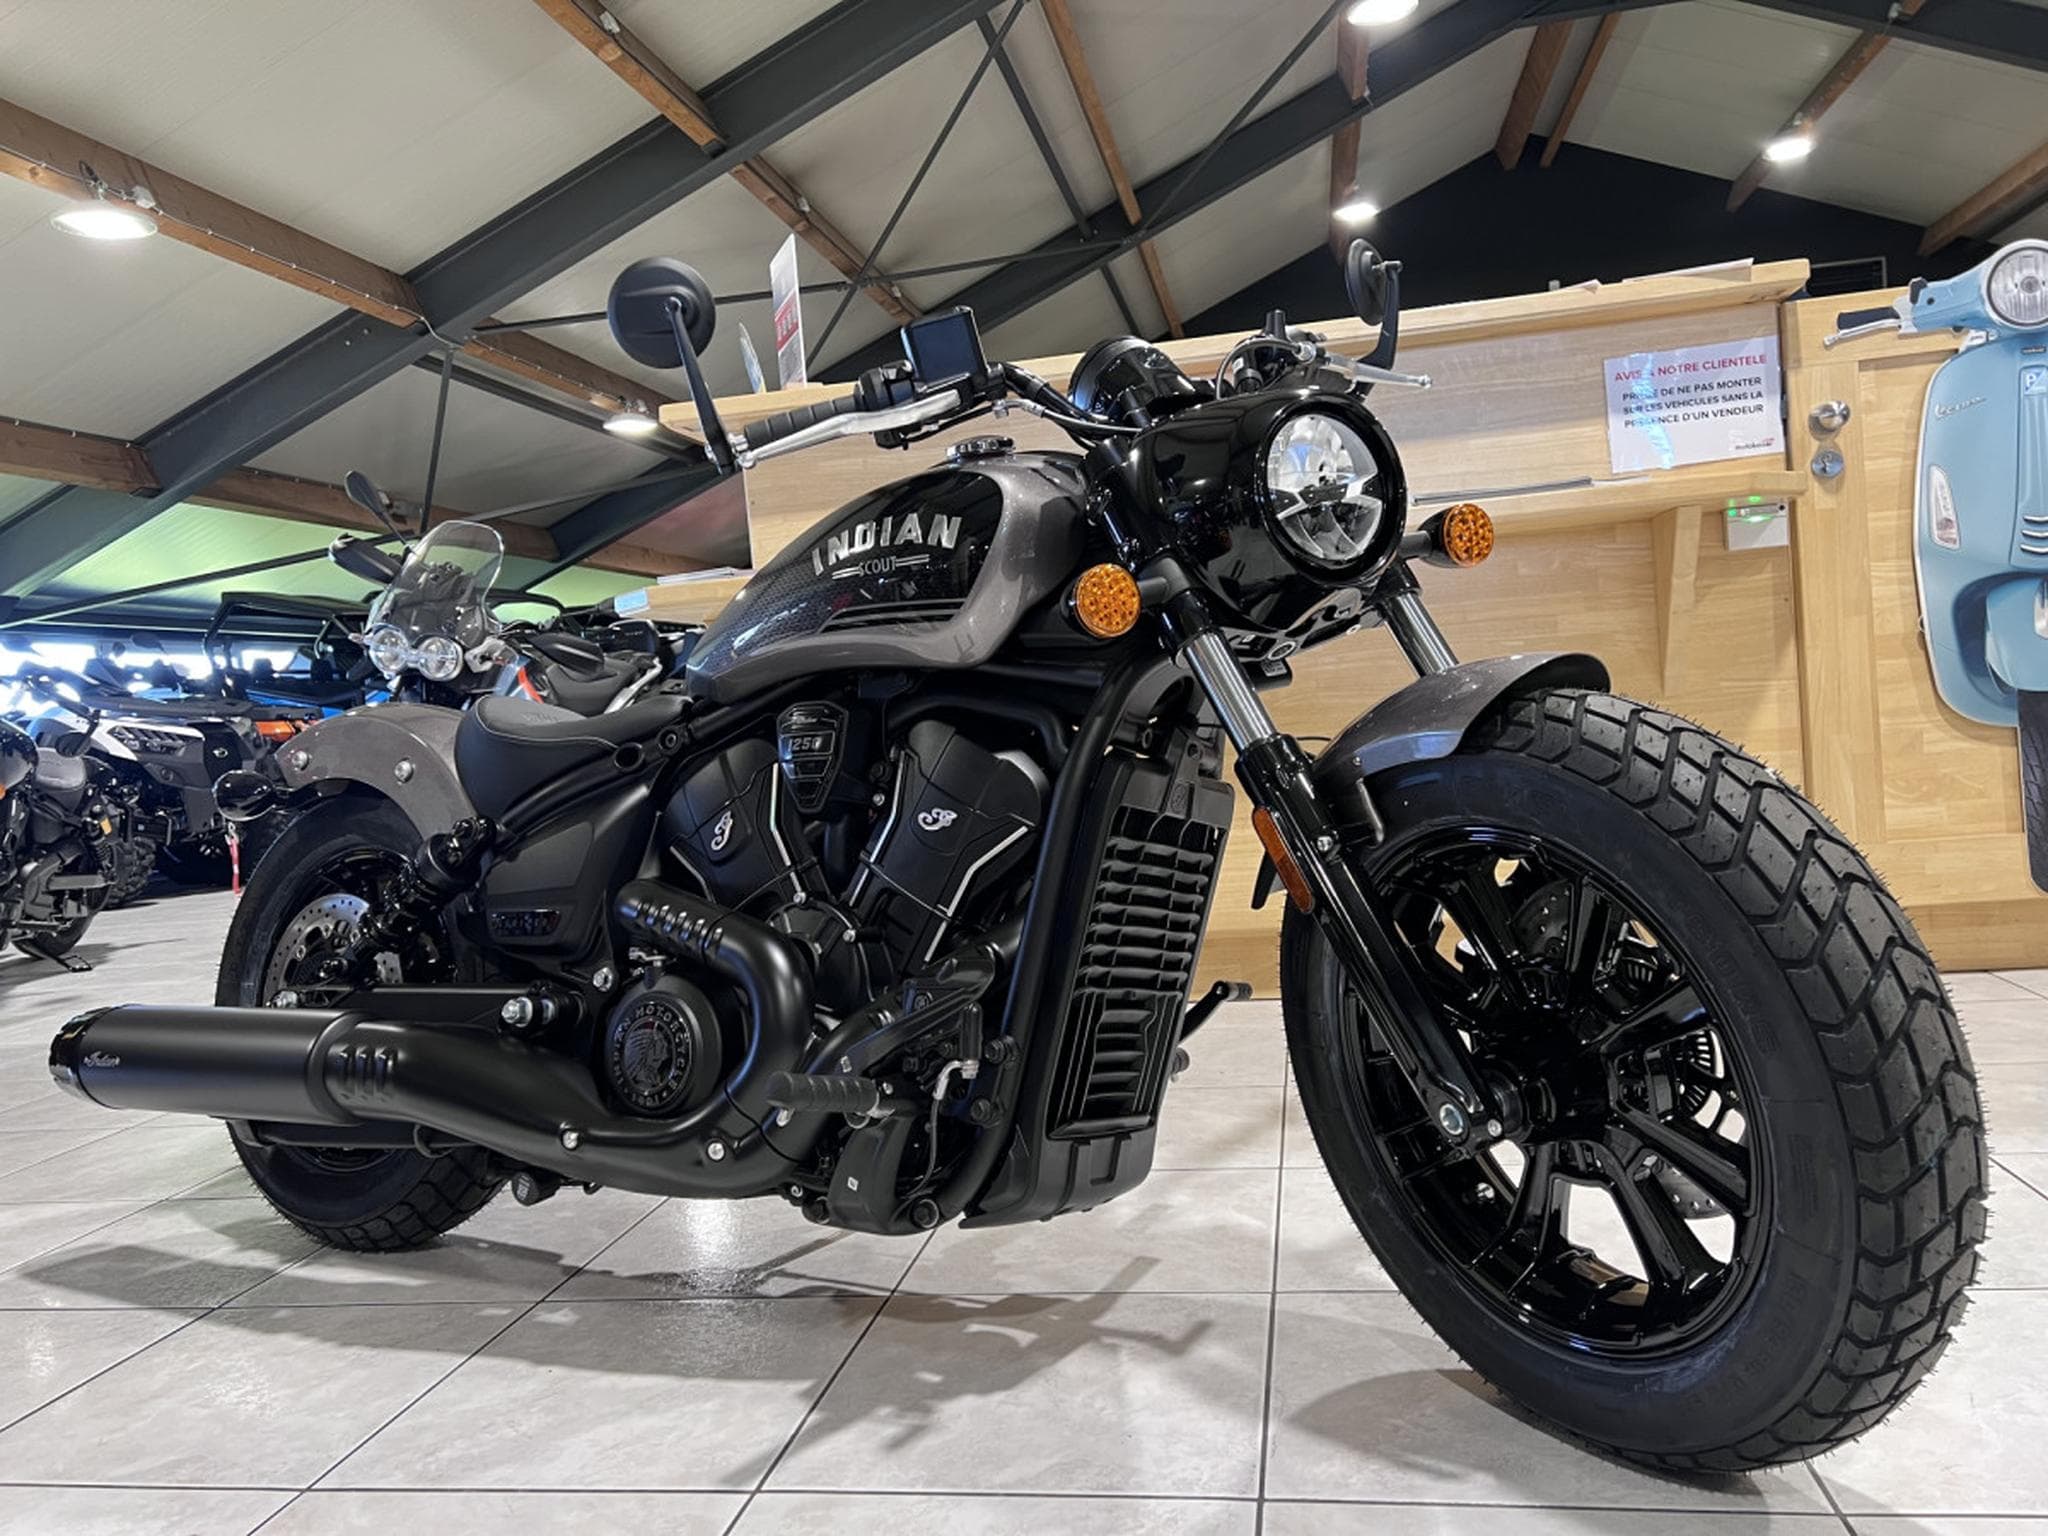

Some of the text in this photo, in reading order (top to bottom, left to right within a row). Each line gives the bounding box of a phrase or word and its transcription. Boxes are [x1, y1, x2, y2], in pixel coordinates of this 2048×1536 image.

[1658, 362, 1699, 375] NOTRE
[1702, 354, 1767, 371] CLIENTELE
[1660, 386, 1675, 397] DE
[1677, 385, 1691, 395] NE
[1694, 382, 1714, 393] PAS
[1716, 376, 1762, 389] MONTER
[1721, 392, 1748, 402] SANS
[1750, 390, 1763, 400] LA
[1712, 404, 1764, 418] VENDEUR
[811, 512, 962, 576] INDIAN
[858, 555, 898, 577] SCOUT
